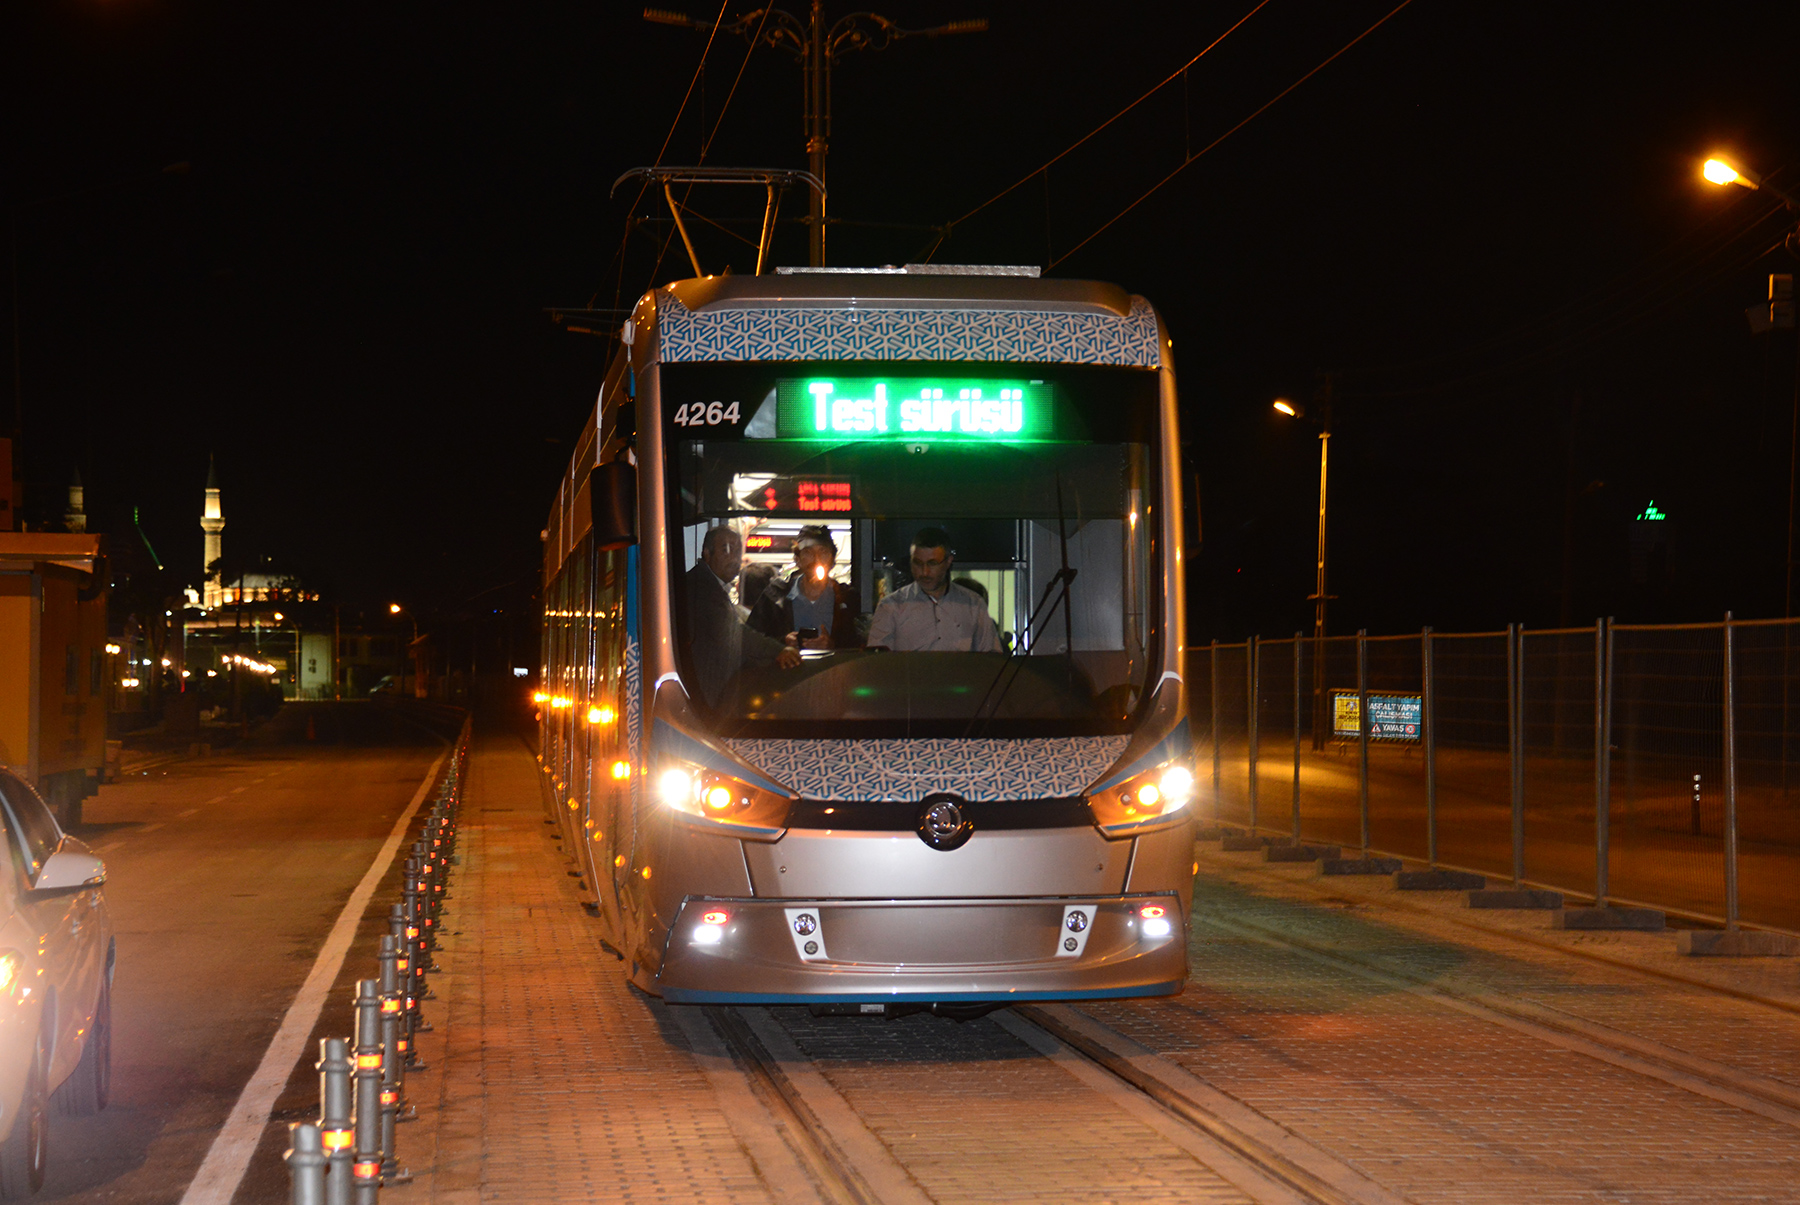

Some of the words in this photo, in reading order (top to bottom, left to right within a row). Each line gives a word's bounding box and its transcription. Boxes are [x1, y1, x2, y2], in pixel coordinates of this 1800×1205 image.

[674, 401, 741, 427] 4264
[809, 382, 888, 431] Test
[900, 389, 1023, 433] sürüşü
[1369, 702, 1395, 711] ASFALT
[1396, 703, 1420, 712] YAPIM
[1382, 723, 1404, 733] YAVAŞ
